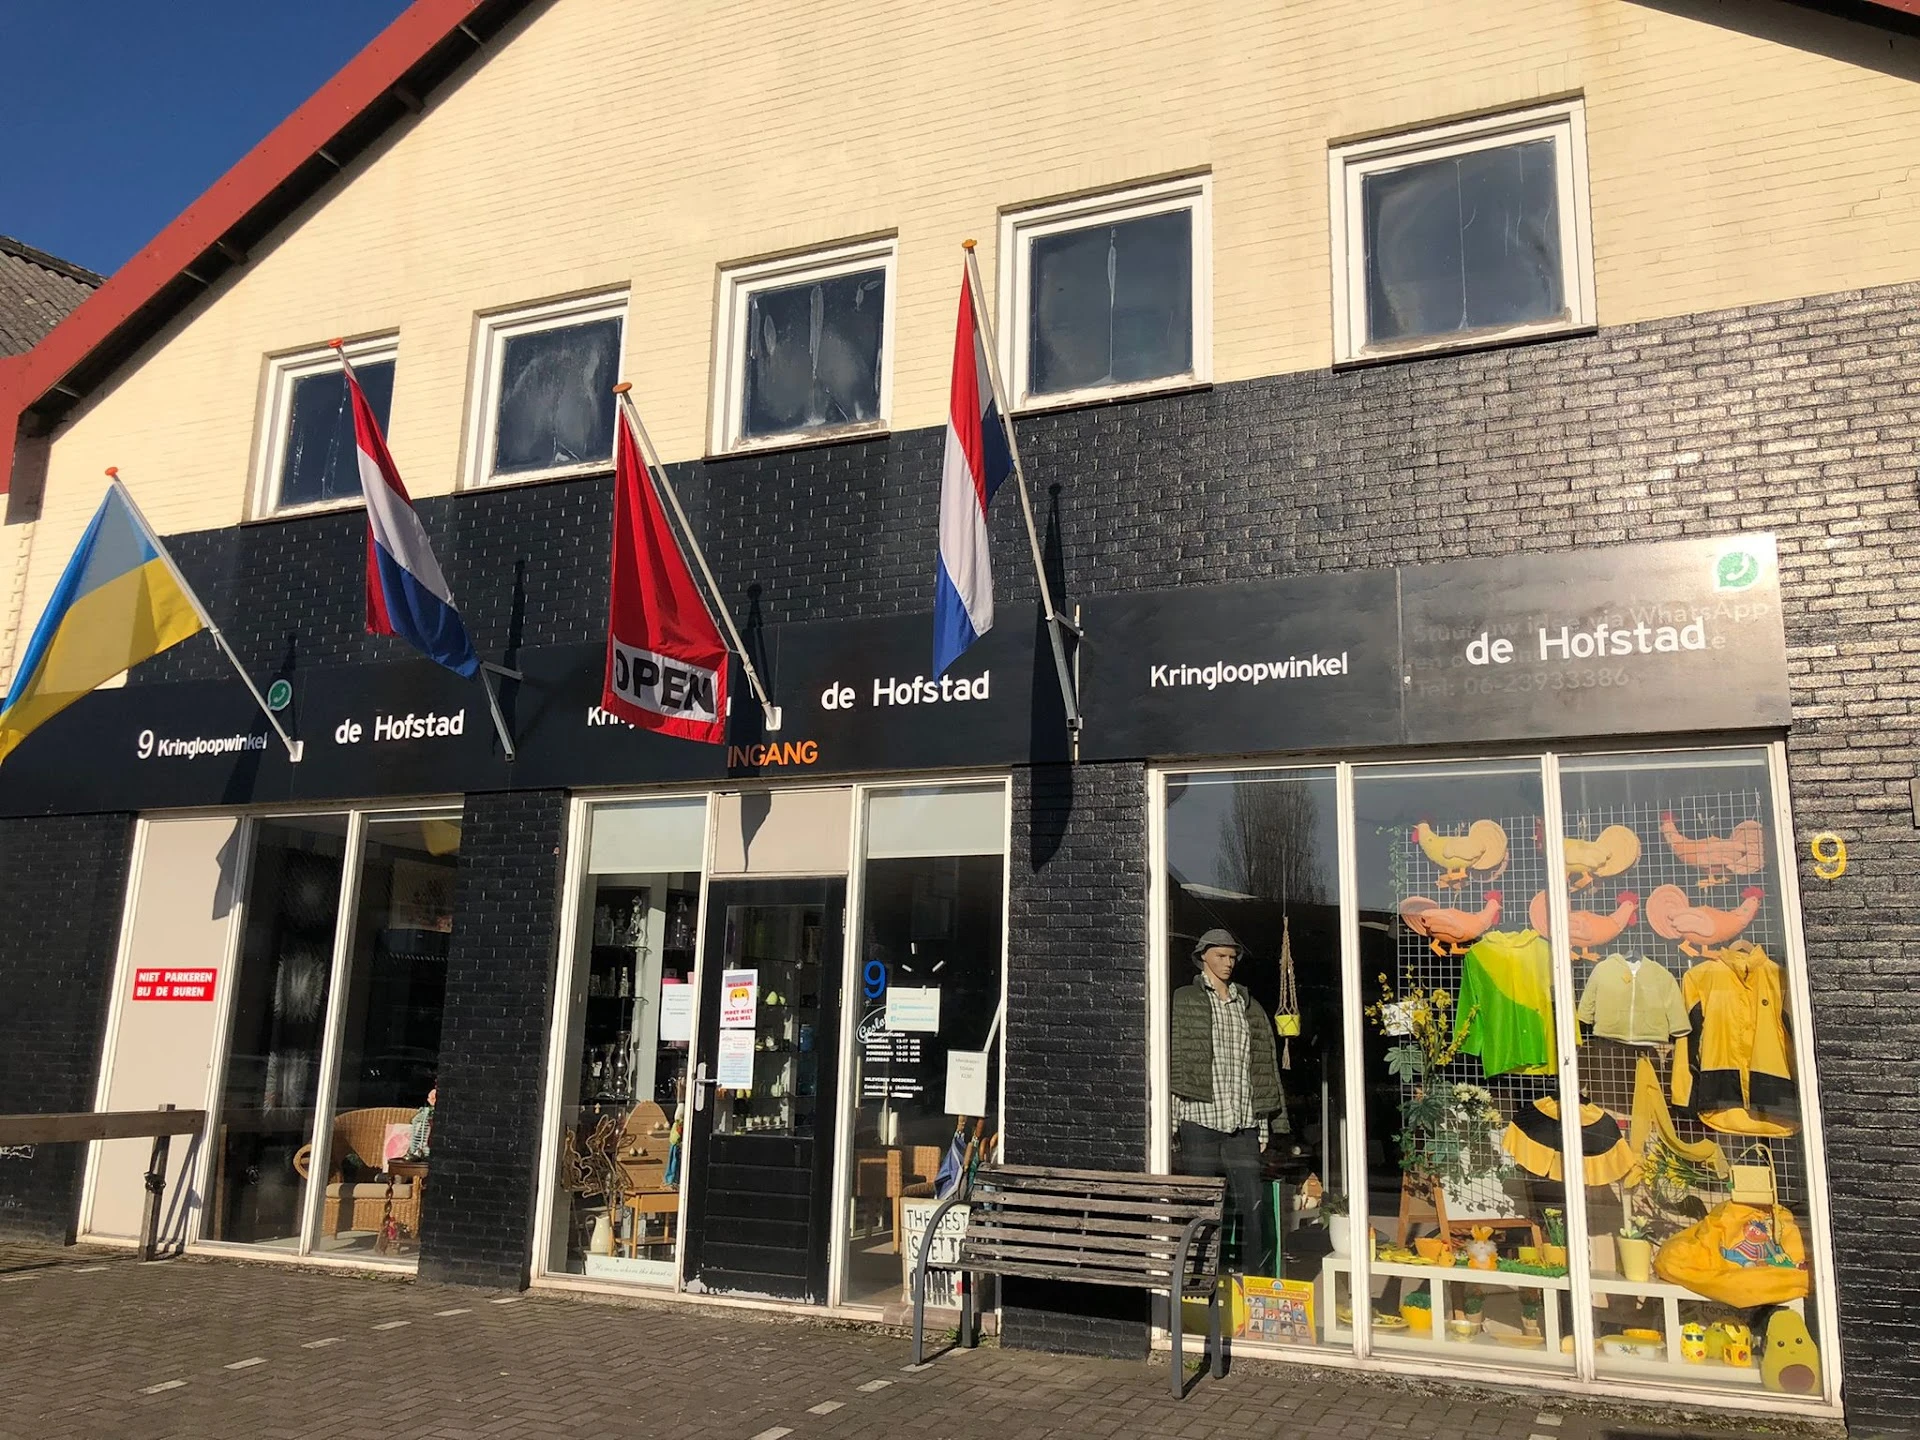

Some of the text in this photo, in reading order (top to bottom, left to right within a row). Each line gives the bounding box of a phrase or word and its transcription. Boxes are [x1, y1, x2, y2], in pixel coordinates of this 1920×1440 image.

[1587, 608, 1625, 629] via
[1629, 600, 1769, 626] WhatsApp
[1465, 631, 1514, 665] de
[1539, 615, 1706, 660] Hofstad
[615, 648, 715, 714] OPEN
[1151, 651, 1348, 690] Kringloopwinkel
[1464, 666, 1630, 696] 06-23933386
[821, 669, 990, 710] de Hofstad
[334, 708, 465, 745] de Hofstad
[137, 729, 155, 759] 9
[157, 731, 268, 760] Kringloopwinkel
[727, 739, 818, 768] INGANG
[1811, 830, 1848, 880] 9
[136, 985, 205, 997] BIJ DE BUREN
[138, 971, 213, 983] NIET PARKEREN
[863, 959, 886, 999] 9
[906, 1209, 931, 1229] THE
